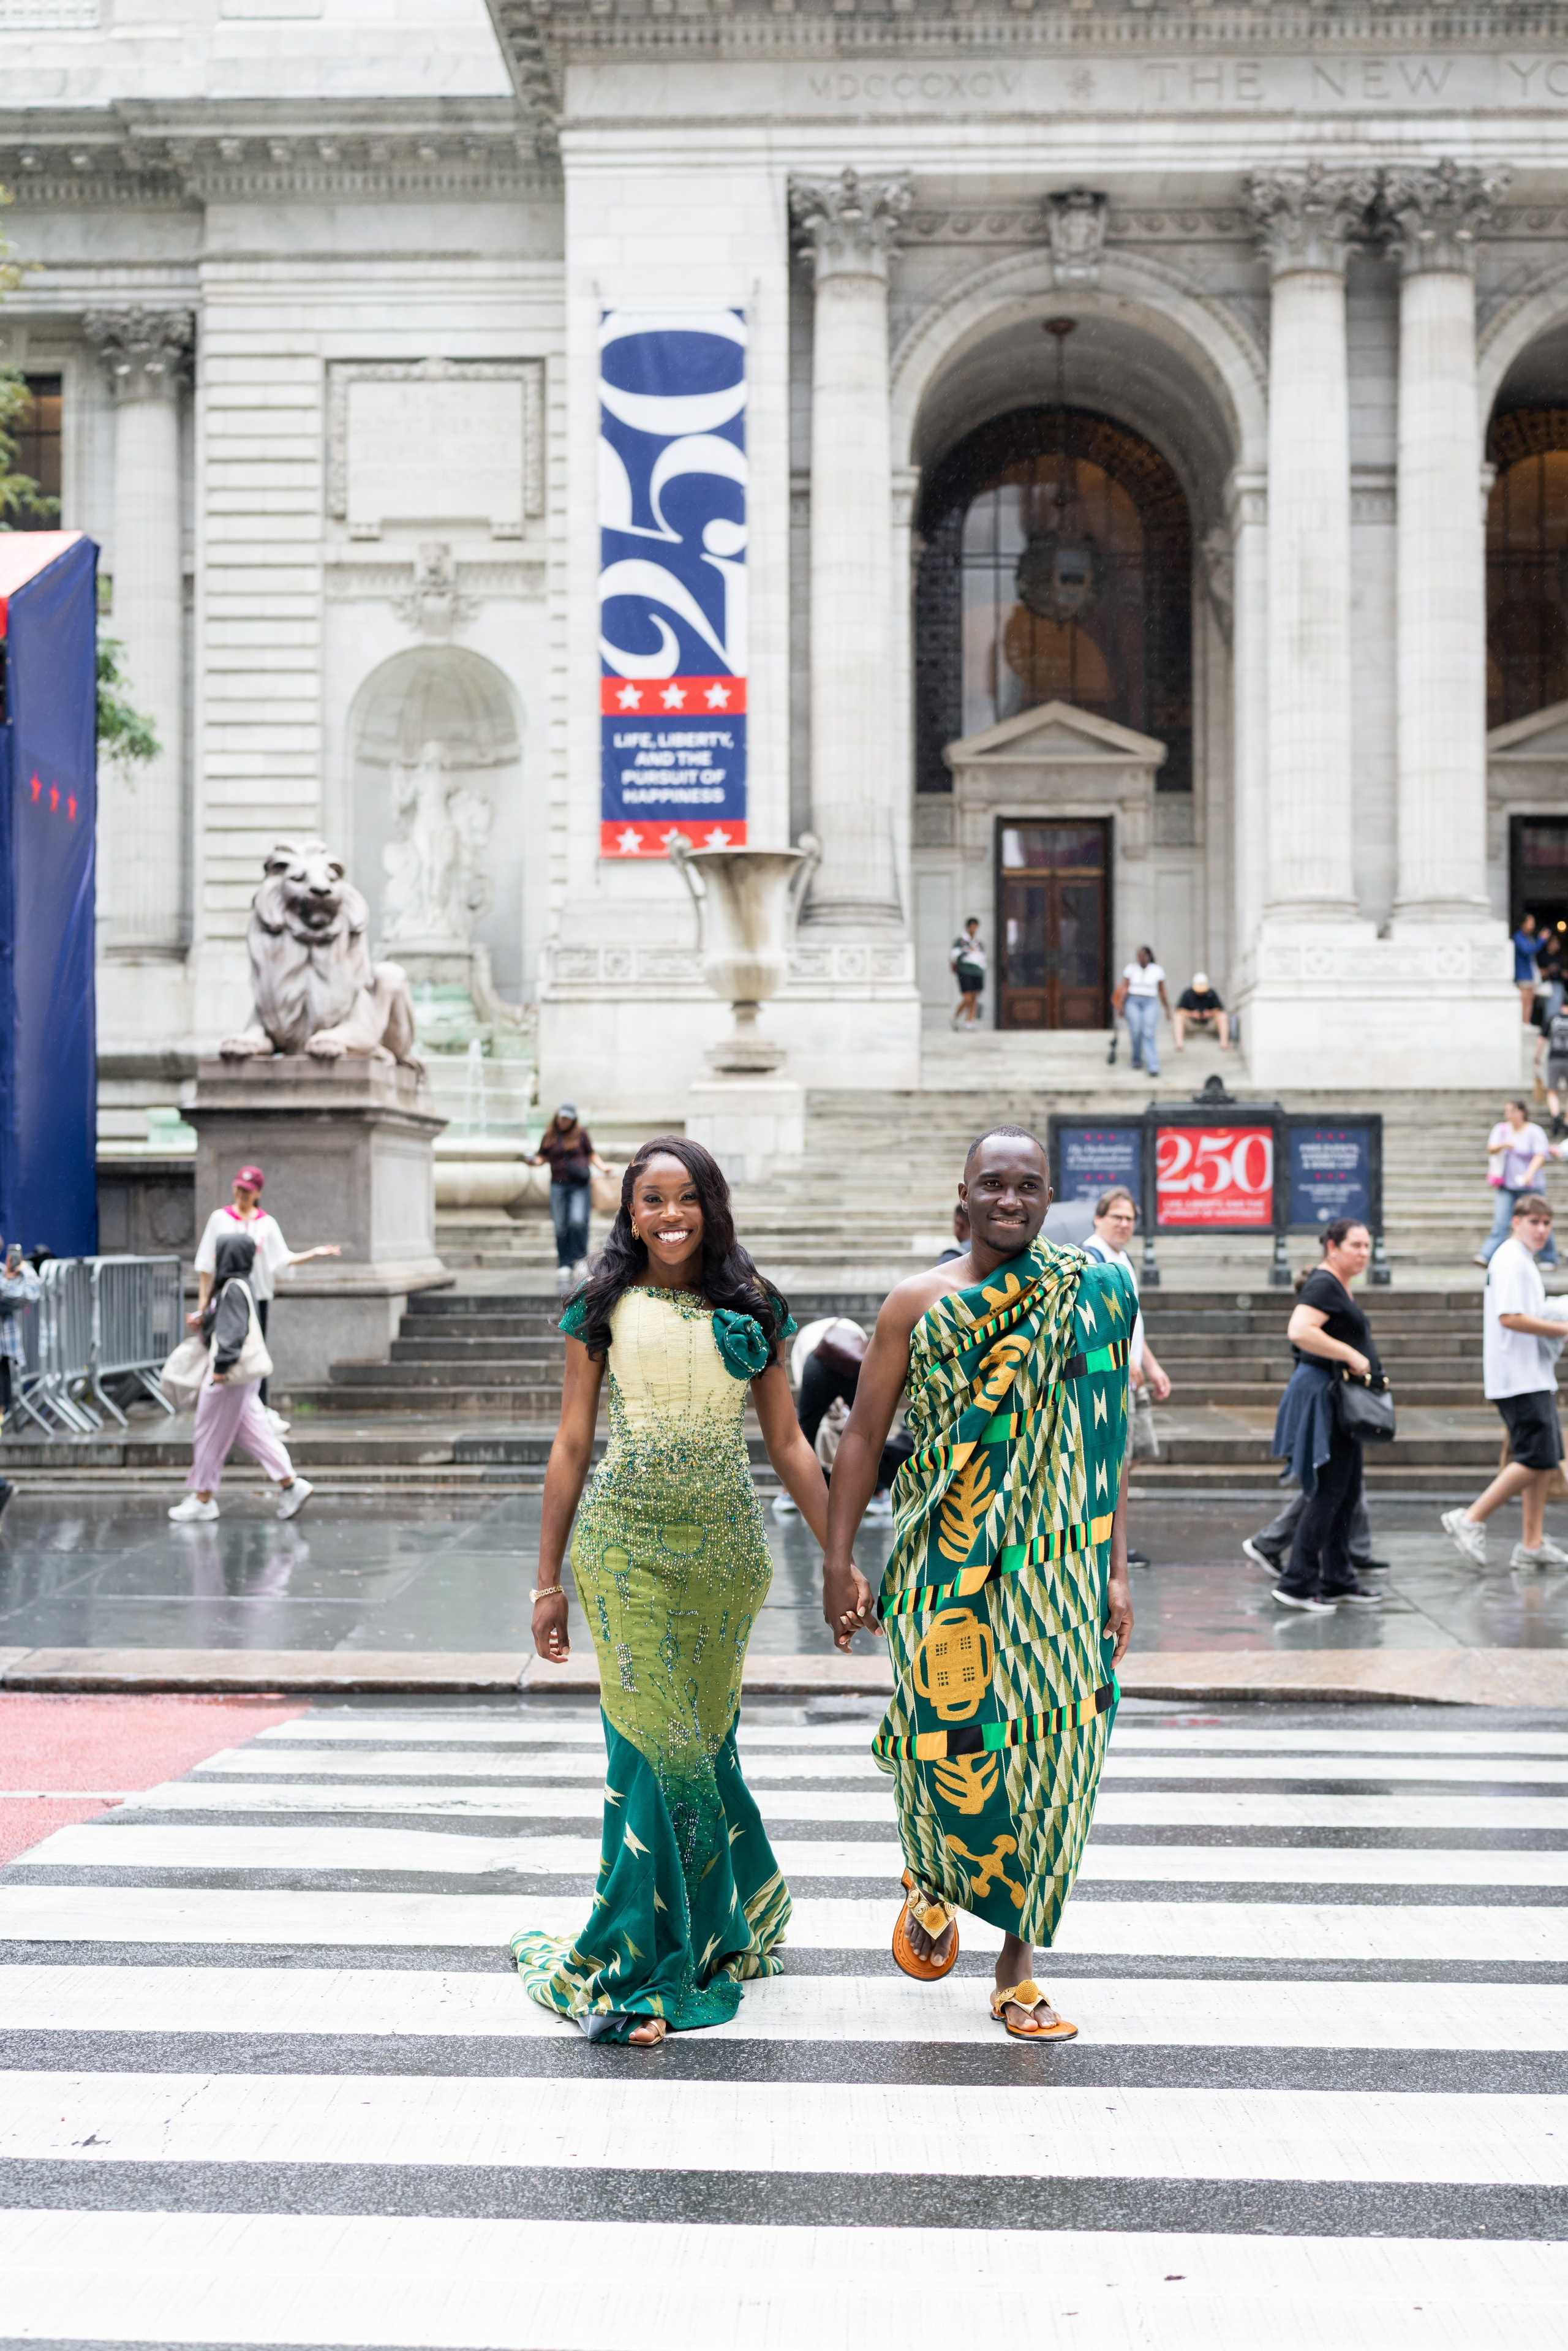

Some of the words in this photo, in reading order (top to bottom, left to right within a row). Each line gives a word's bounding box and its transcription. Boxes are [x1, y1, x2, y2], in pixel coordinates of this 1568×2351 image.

[1145, 61, 1265, 102] THE
[1312, 61, 1454, 100] NEW
[599, 309, 746, 679] 250
[613, 732, 657, 750] LIFE,
[657, 731, 734, 750] LIBERTY,
[634, 751, 674, 766] AND
[676, 750, 713, 766] THE
[621, 769, 699, 785] PURSUIT
[699, 768, 726, 785] OF
[622, 787, 726, 804] HAPPINESS
[1156, 1134, 1273, 1194] 250
